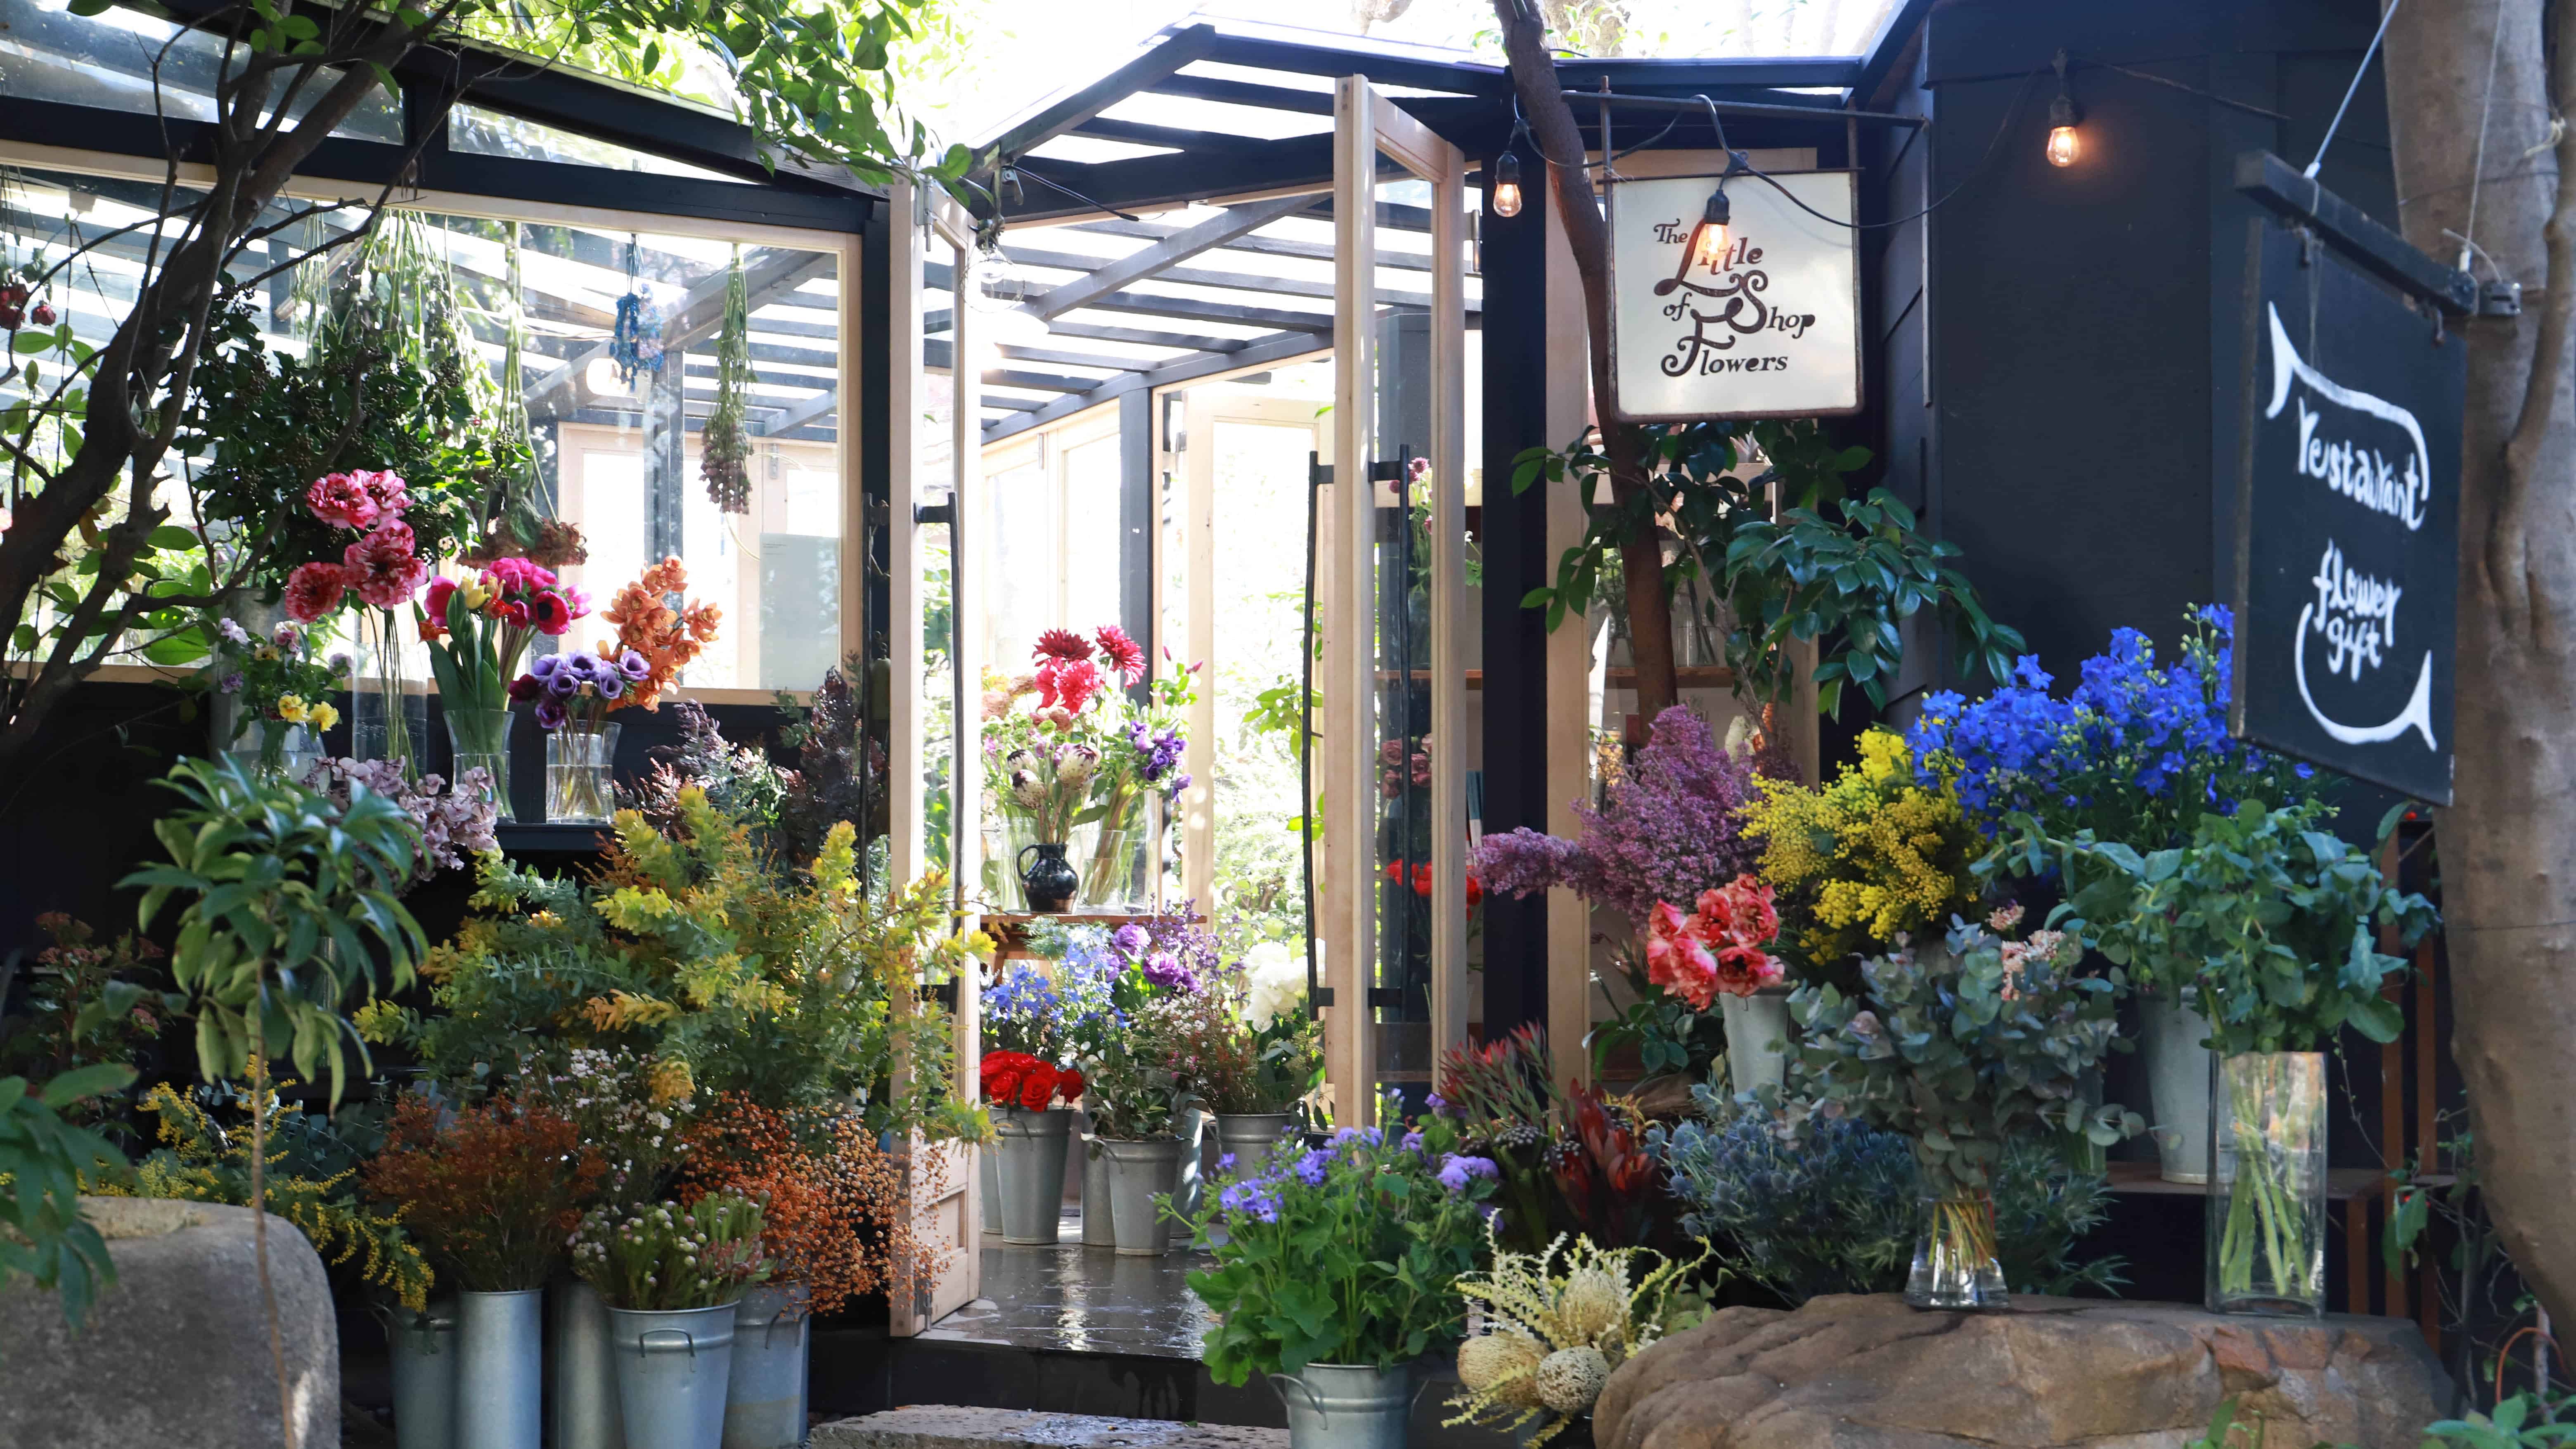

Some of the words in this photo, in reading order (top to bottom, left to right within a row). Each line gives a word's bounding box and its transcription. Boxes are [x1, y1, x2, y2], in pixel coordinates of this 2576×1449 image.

[1653, 218, 1688, 244] The
[1663, 292, 1692, 321] of
[1724, 269, 1816, 339] Shop
[1661, 308, 1788, 377] Flowers
[2298, 395, 2426, 530] restaurant
[2312, 537, 2402, 648] flower
[2326, 608, 2382, 683] gift
